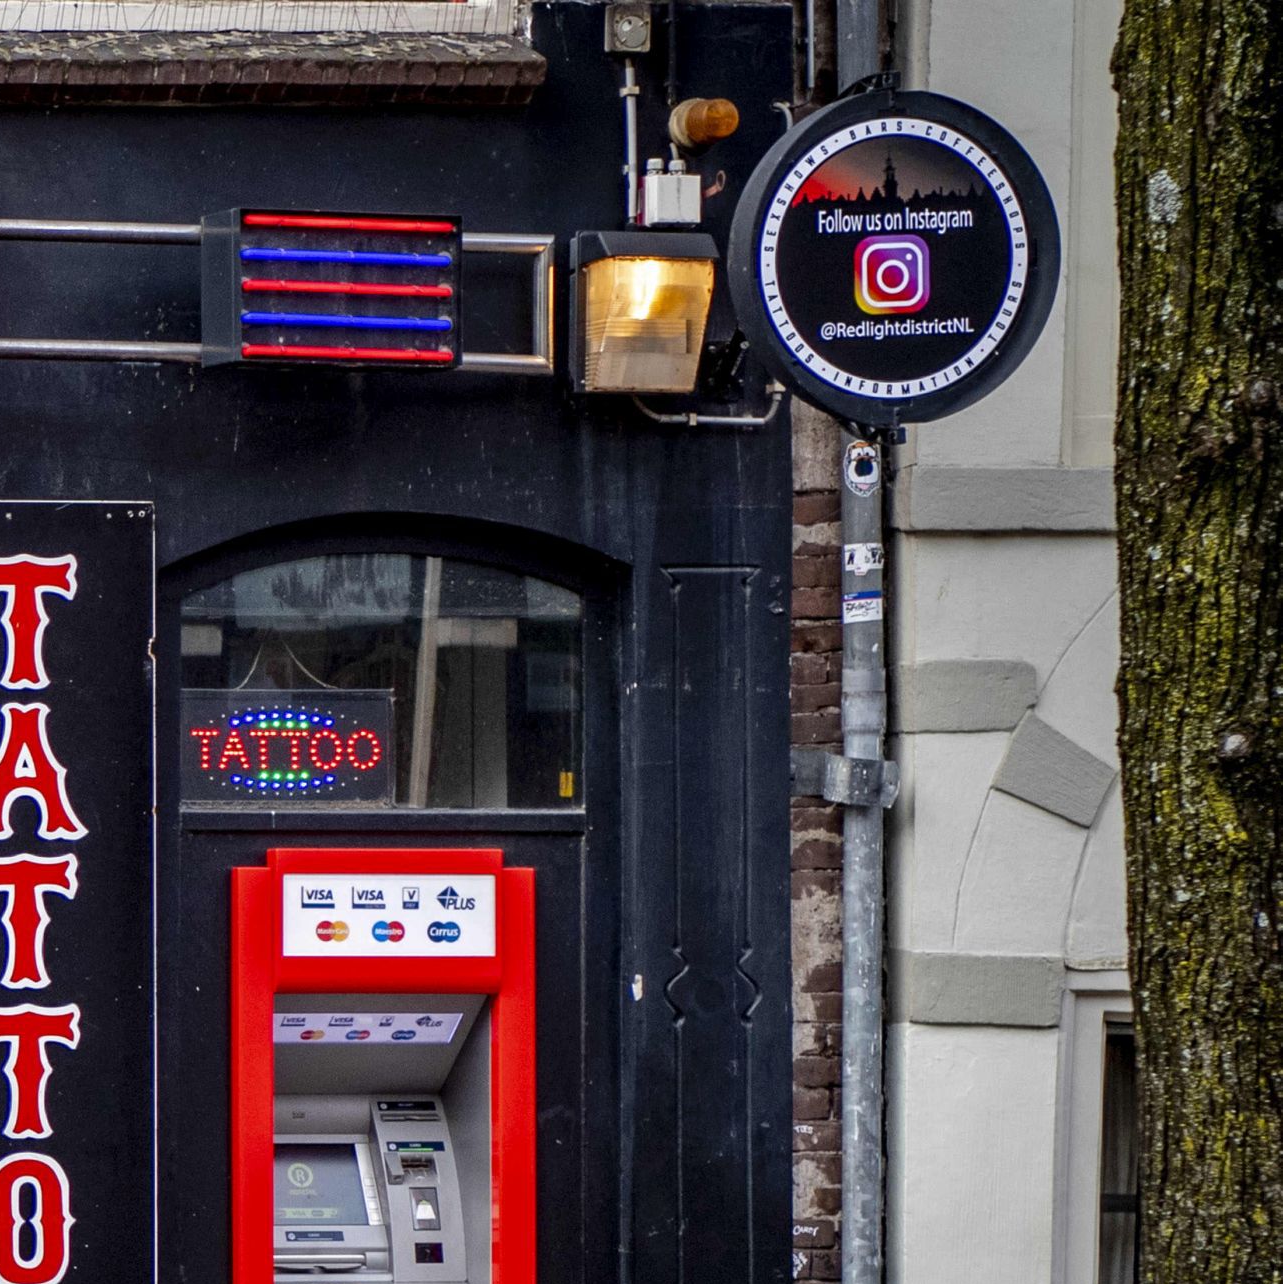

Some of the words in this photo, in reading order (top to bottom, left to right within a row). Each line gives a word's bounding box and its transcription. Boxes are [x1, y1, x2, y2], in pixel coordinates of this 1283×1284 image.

[849, 120, 903, 141] BARS
[764, 144, 829, 252] SEXSHOWS
[925, 125, 1026, 250] COFFEESHOPS
[818, 209, 863, 233] Follow
[866, 214, 881, 231] us
[884, 214, 902, 231] on
[905, 207, 973, 235] Instagram
[764, 280, 814, 364] TATTOOS
[987, 280, 1023, 344] TOURS
[820, 317, 974, 340] @RedlightdistrictNL
[833, 357, 975, 396] INFORMATION
[190, 728, 382, 771] TATTOO
[305, 889, 333, 901] VISA
[357, 889, 384, 901] VISA
[446, 897, 475, 910] PLUS
[375, 927, 403, 936] Maestro
[429, 926, 458, 937] Cirrus
